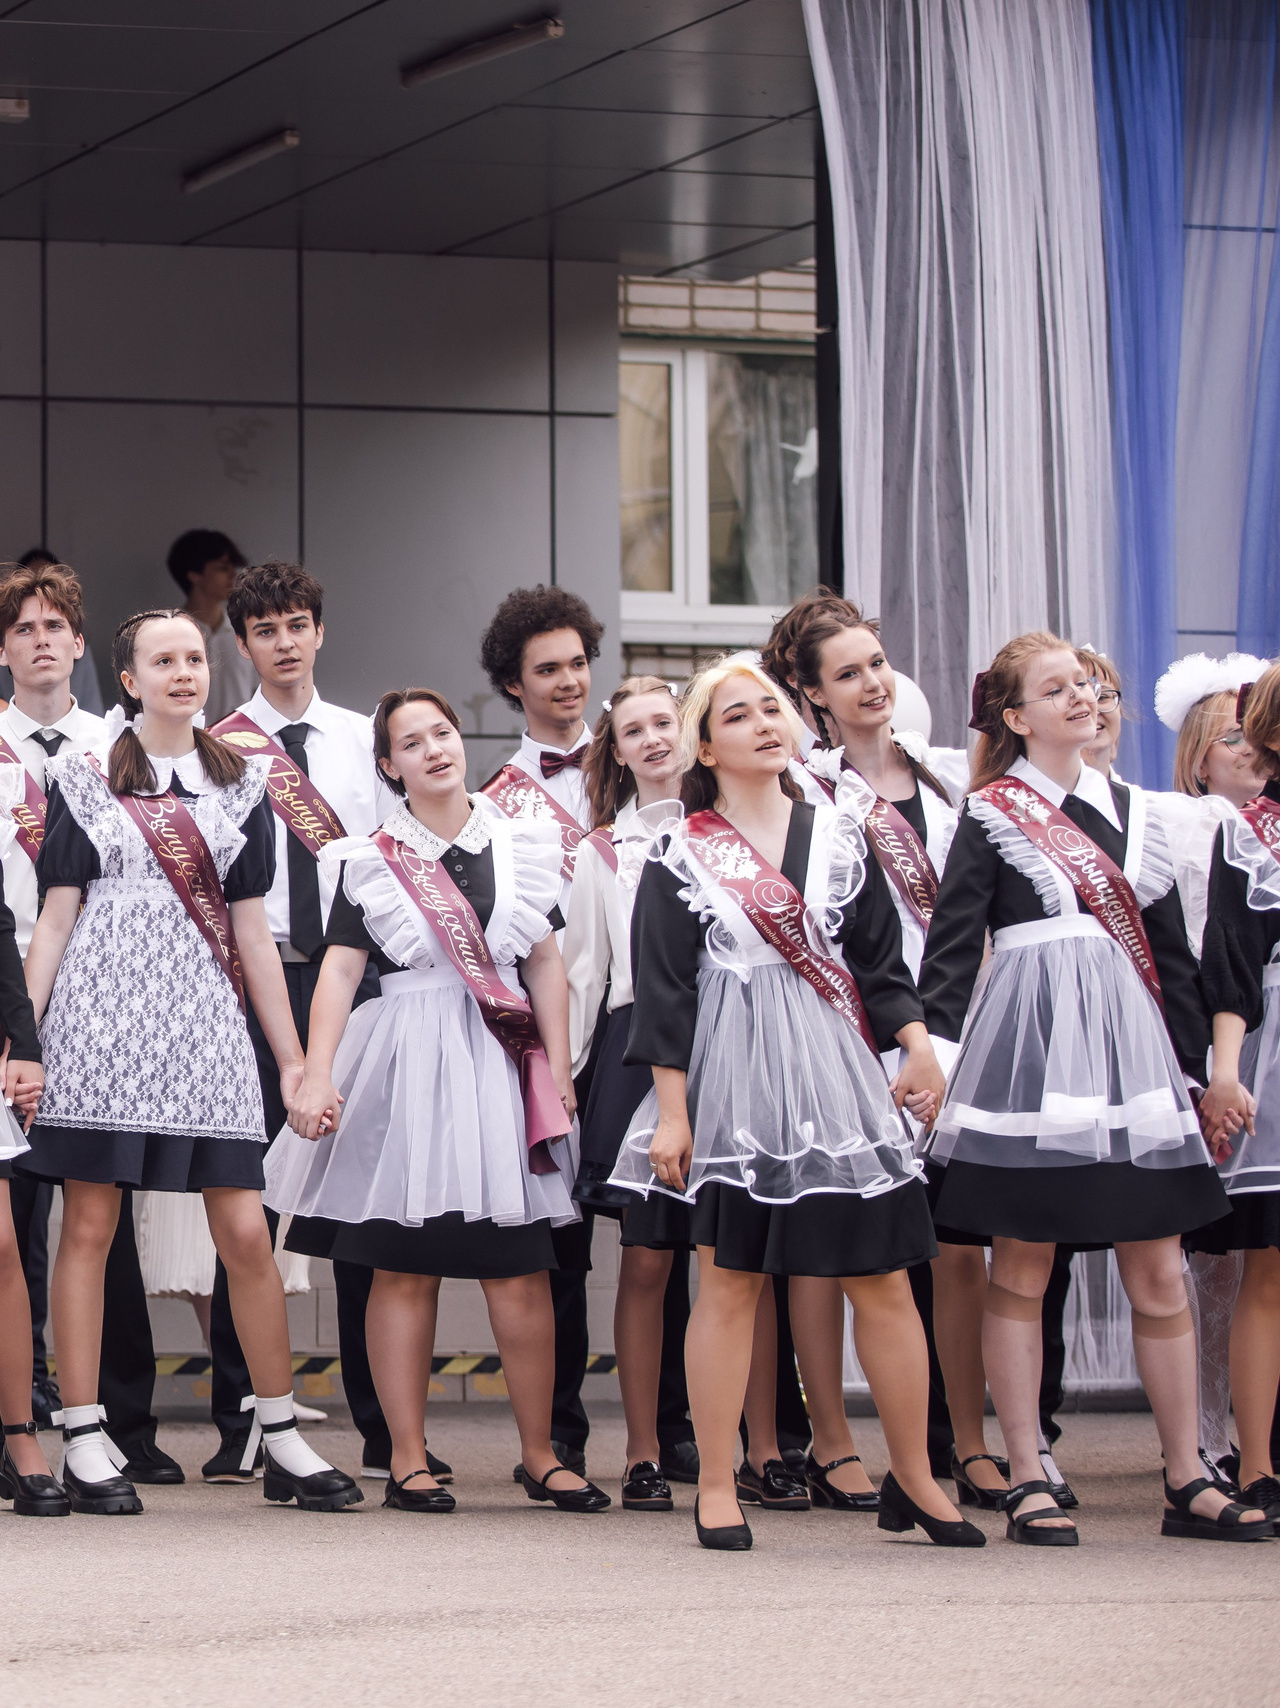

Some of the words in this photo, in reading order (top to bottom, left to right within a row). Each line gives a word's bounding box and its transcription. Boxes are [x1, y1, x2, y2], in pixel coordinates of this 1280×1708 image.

[401, 845, 491, 990] Выпускница
[1048, 825, 1150, 970] Выпускница
[800, 964, 826, 988] МАОУ
[825, 988, 844, 1009] СОШ
